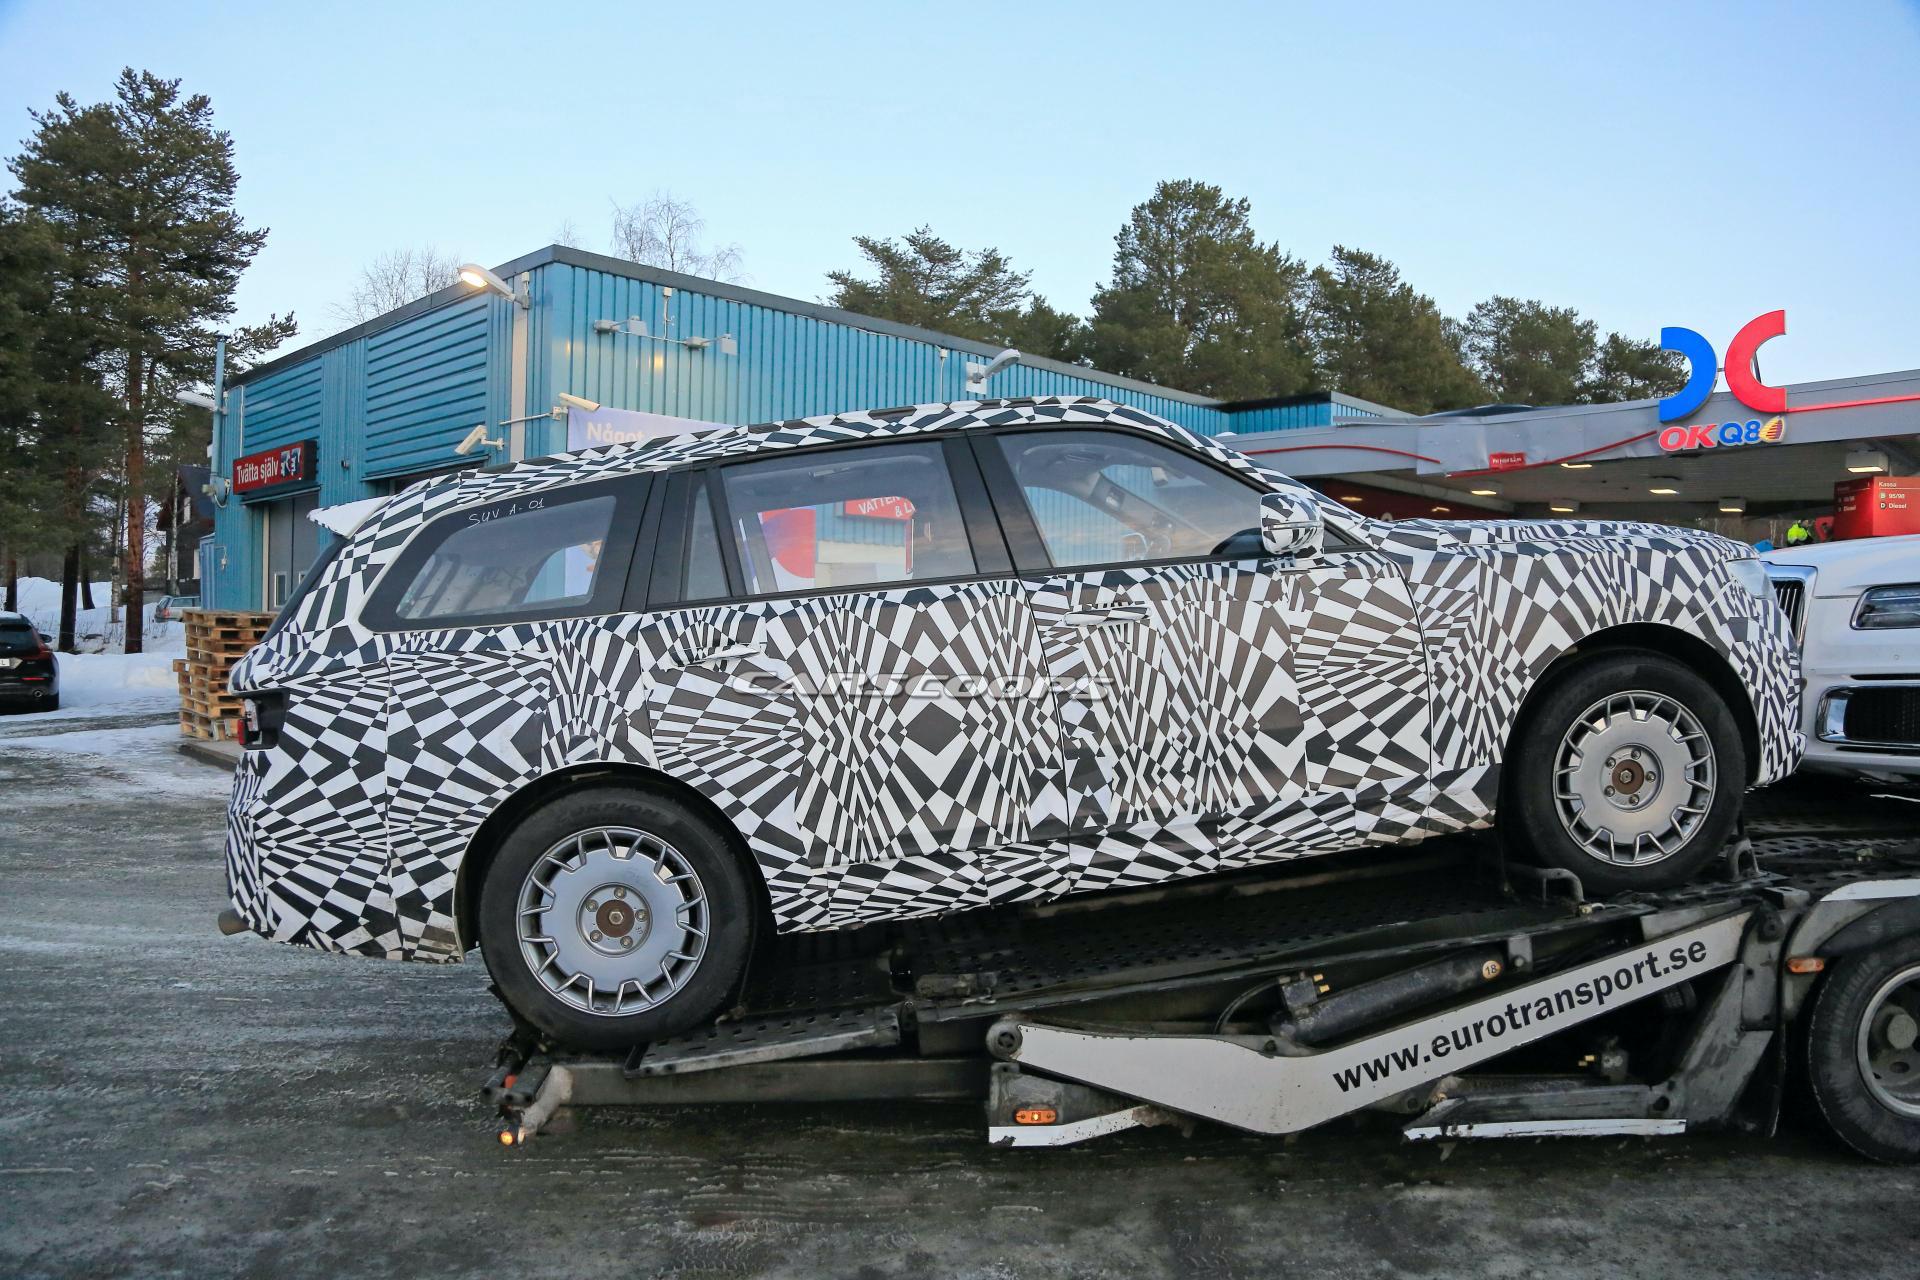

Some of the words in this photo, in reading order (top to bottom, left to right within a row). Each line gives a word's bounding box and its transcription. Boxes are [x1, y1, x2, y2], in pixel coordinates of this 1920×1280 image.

[236, 463, 259, 484] Tvätta
[260, 456, 279, 484] själv
[467, 508, 500, 529] SUV
[1486, 964, 1497, 976] 18
[1332, 940, 1707, 1093] www.eurotransport.se
